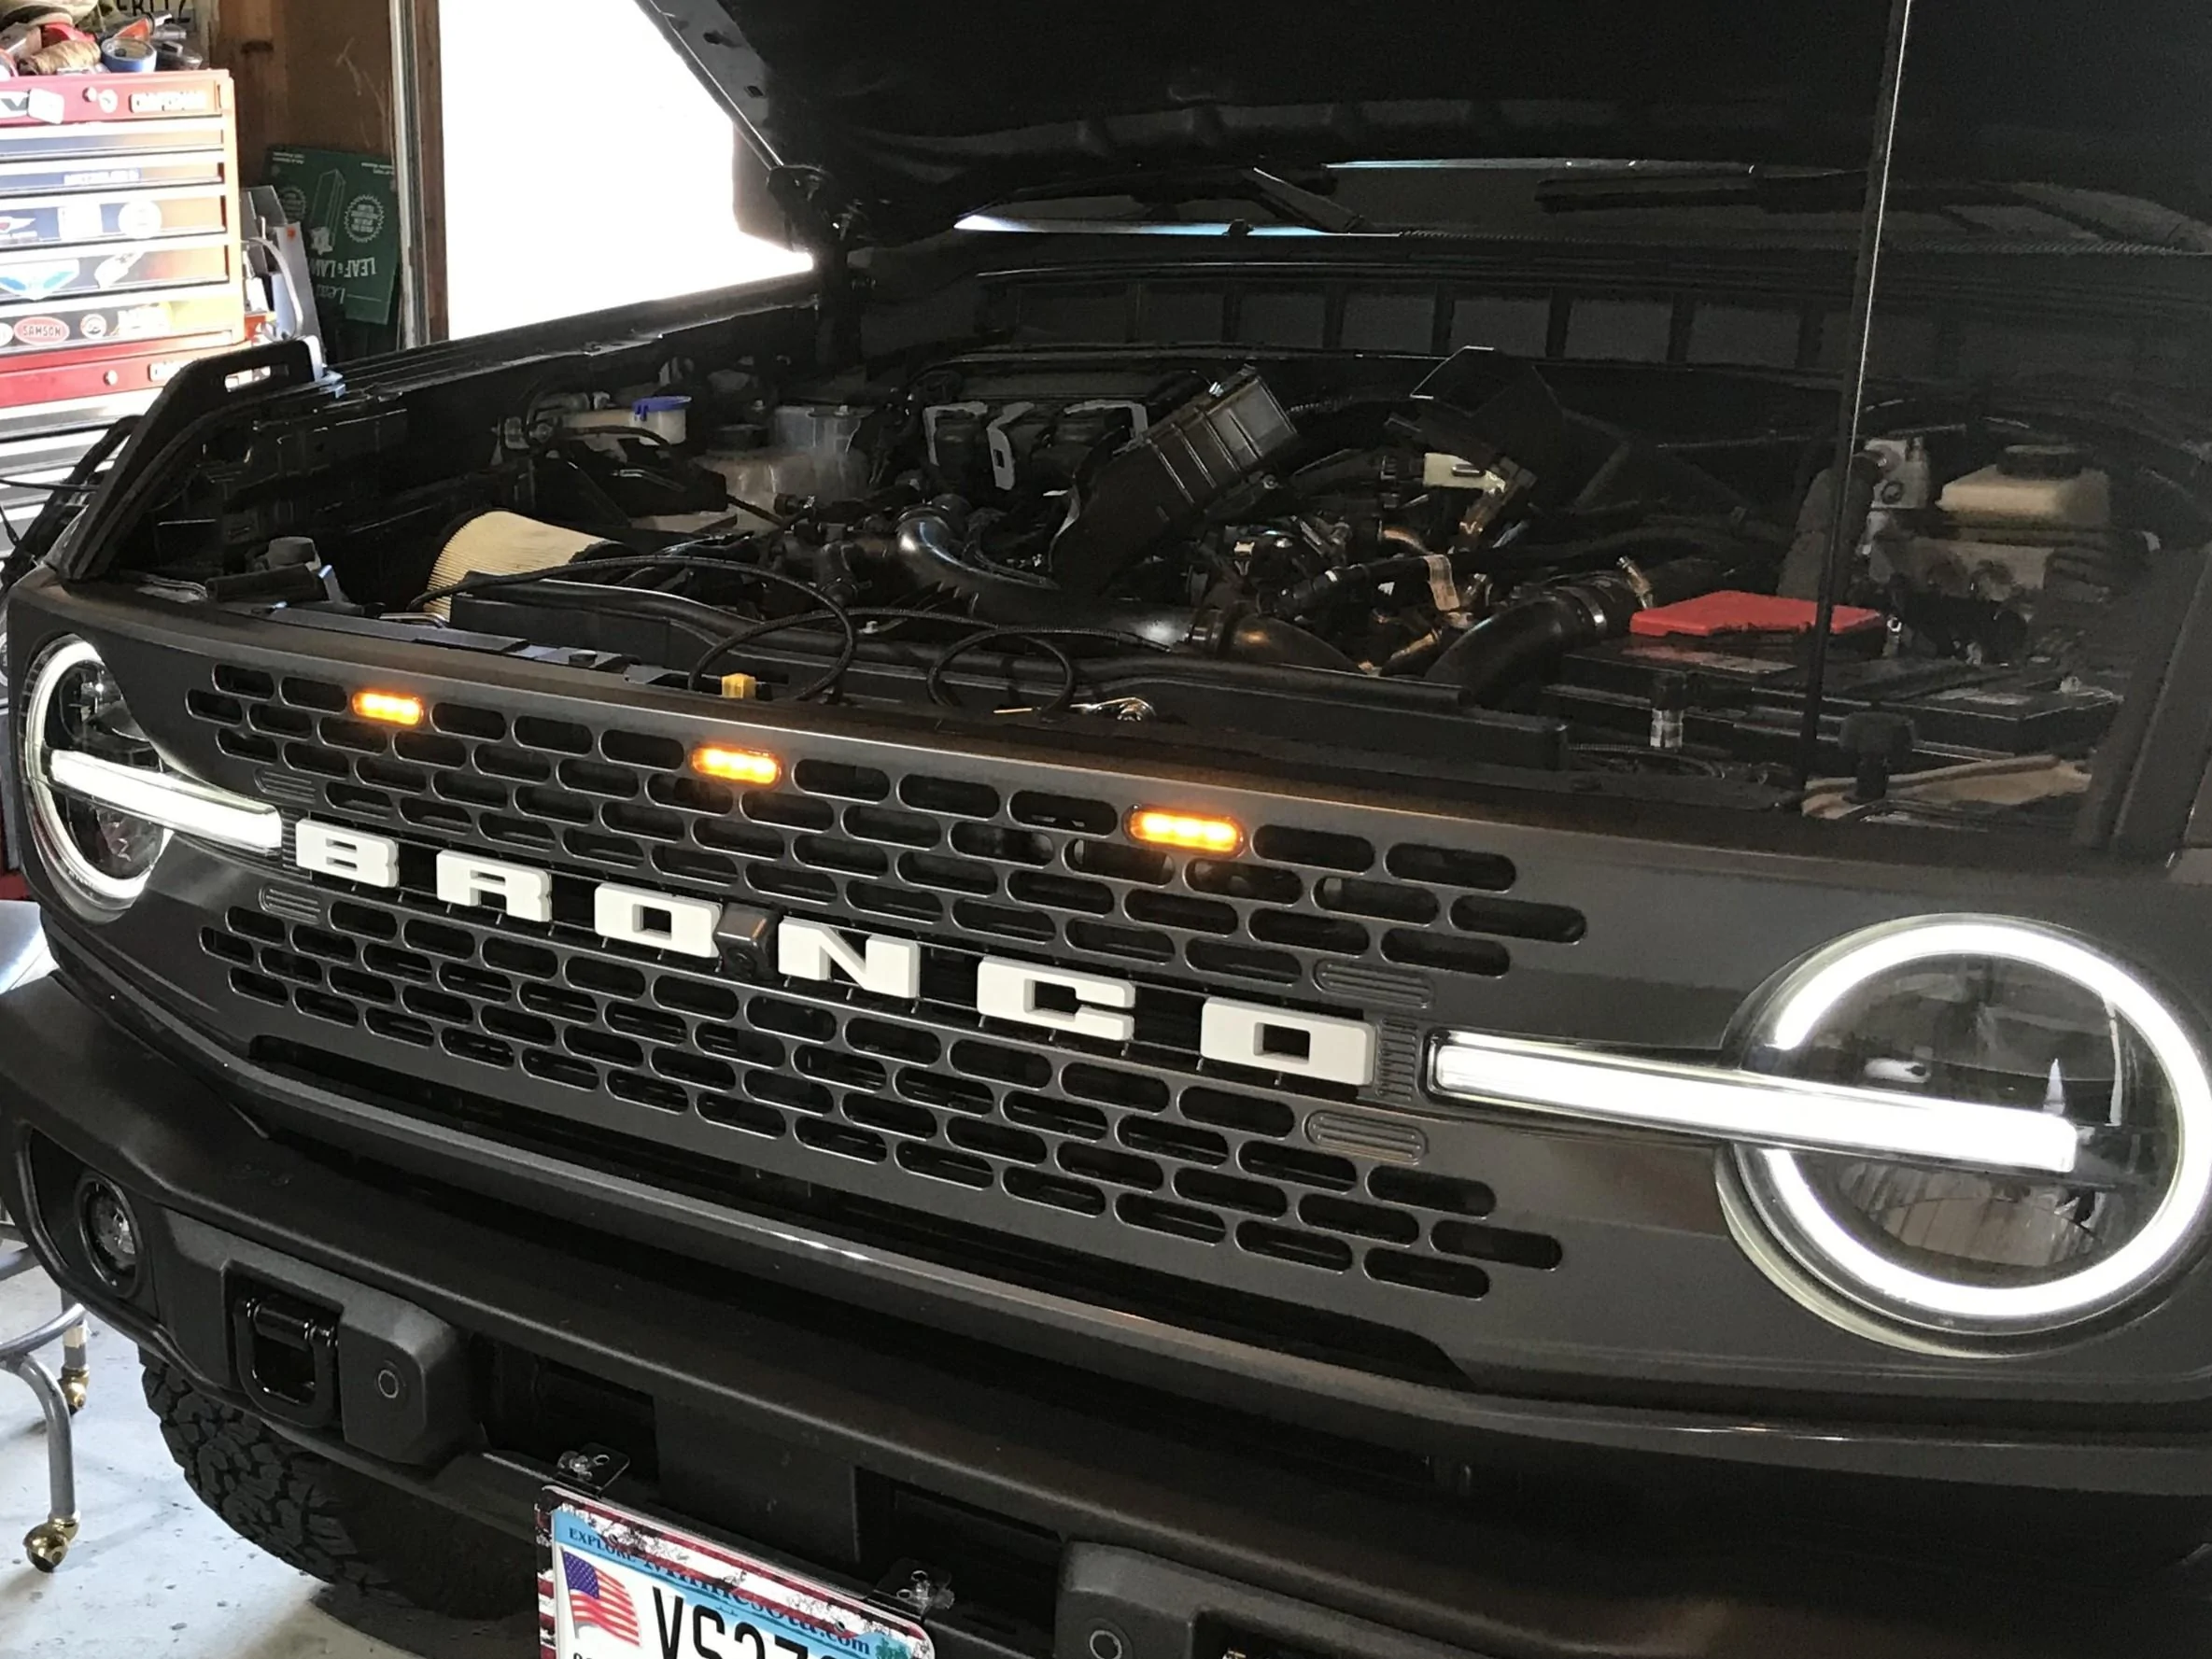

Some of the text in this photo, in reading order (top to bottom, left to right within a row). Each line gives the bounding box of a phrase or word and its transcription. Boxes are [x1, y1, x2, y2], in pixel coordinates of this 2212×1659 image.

[343, 257, 377, 278] LEAF
[22, 324, 62, 337] SAMSON
[296, 819, 1377, 1086] BRONCO
[568, 1527, 637, 1563] EXPLO
